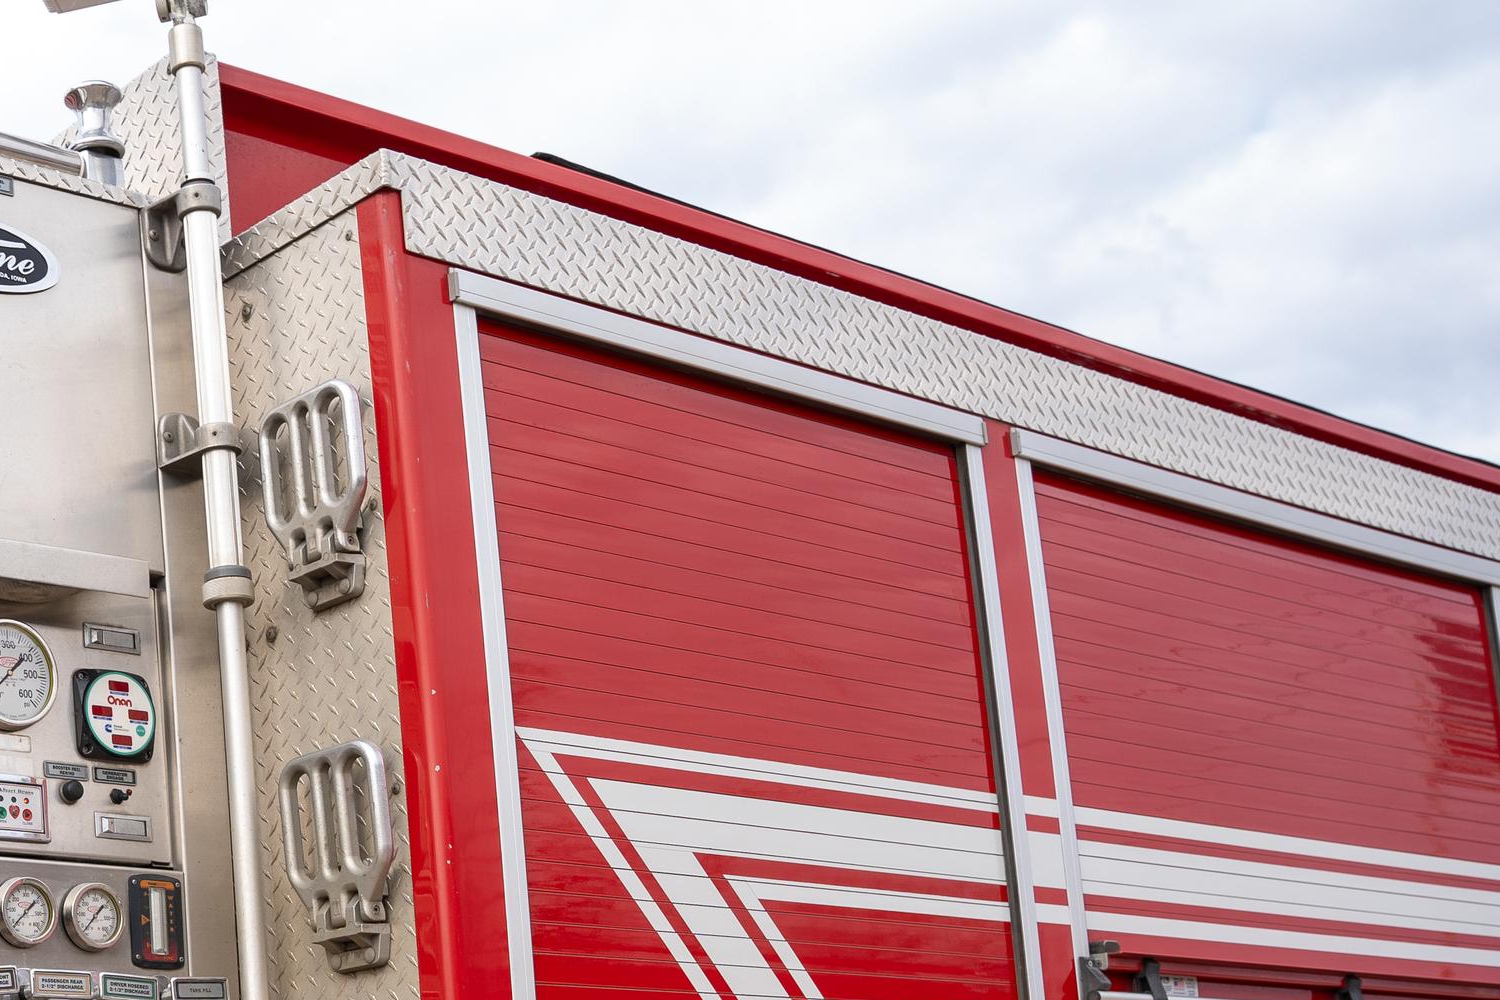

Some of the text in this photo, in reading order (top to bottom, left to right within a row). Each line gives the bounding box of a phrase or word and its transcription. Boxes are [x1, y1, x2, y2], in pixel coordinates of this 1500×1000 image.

[1, 640, 15, 649] 300
[23, 670, 38, 678] 500
[19, 689, 33, 698] 600
